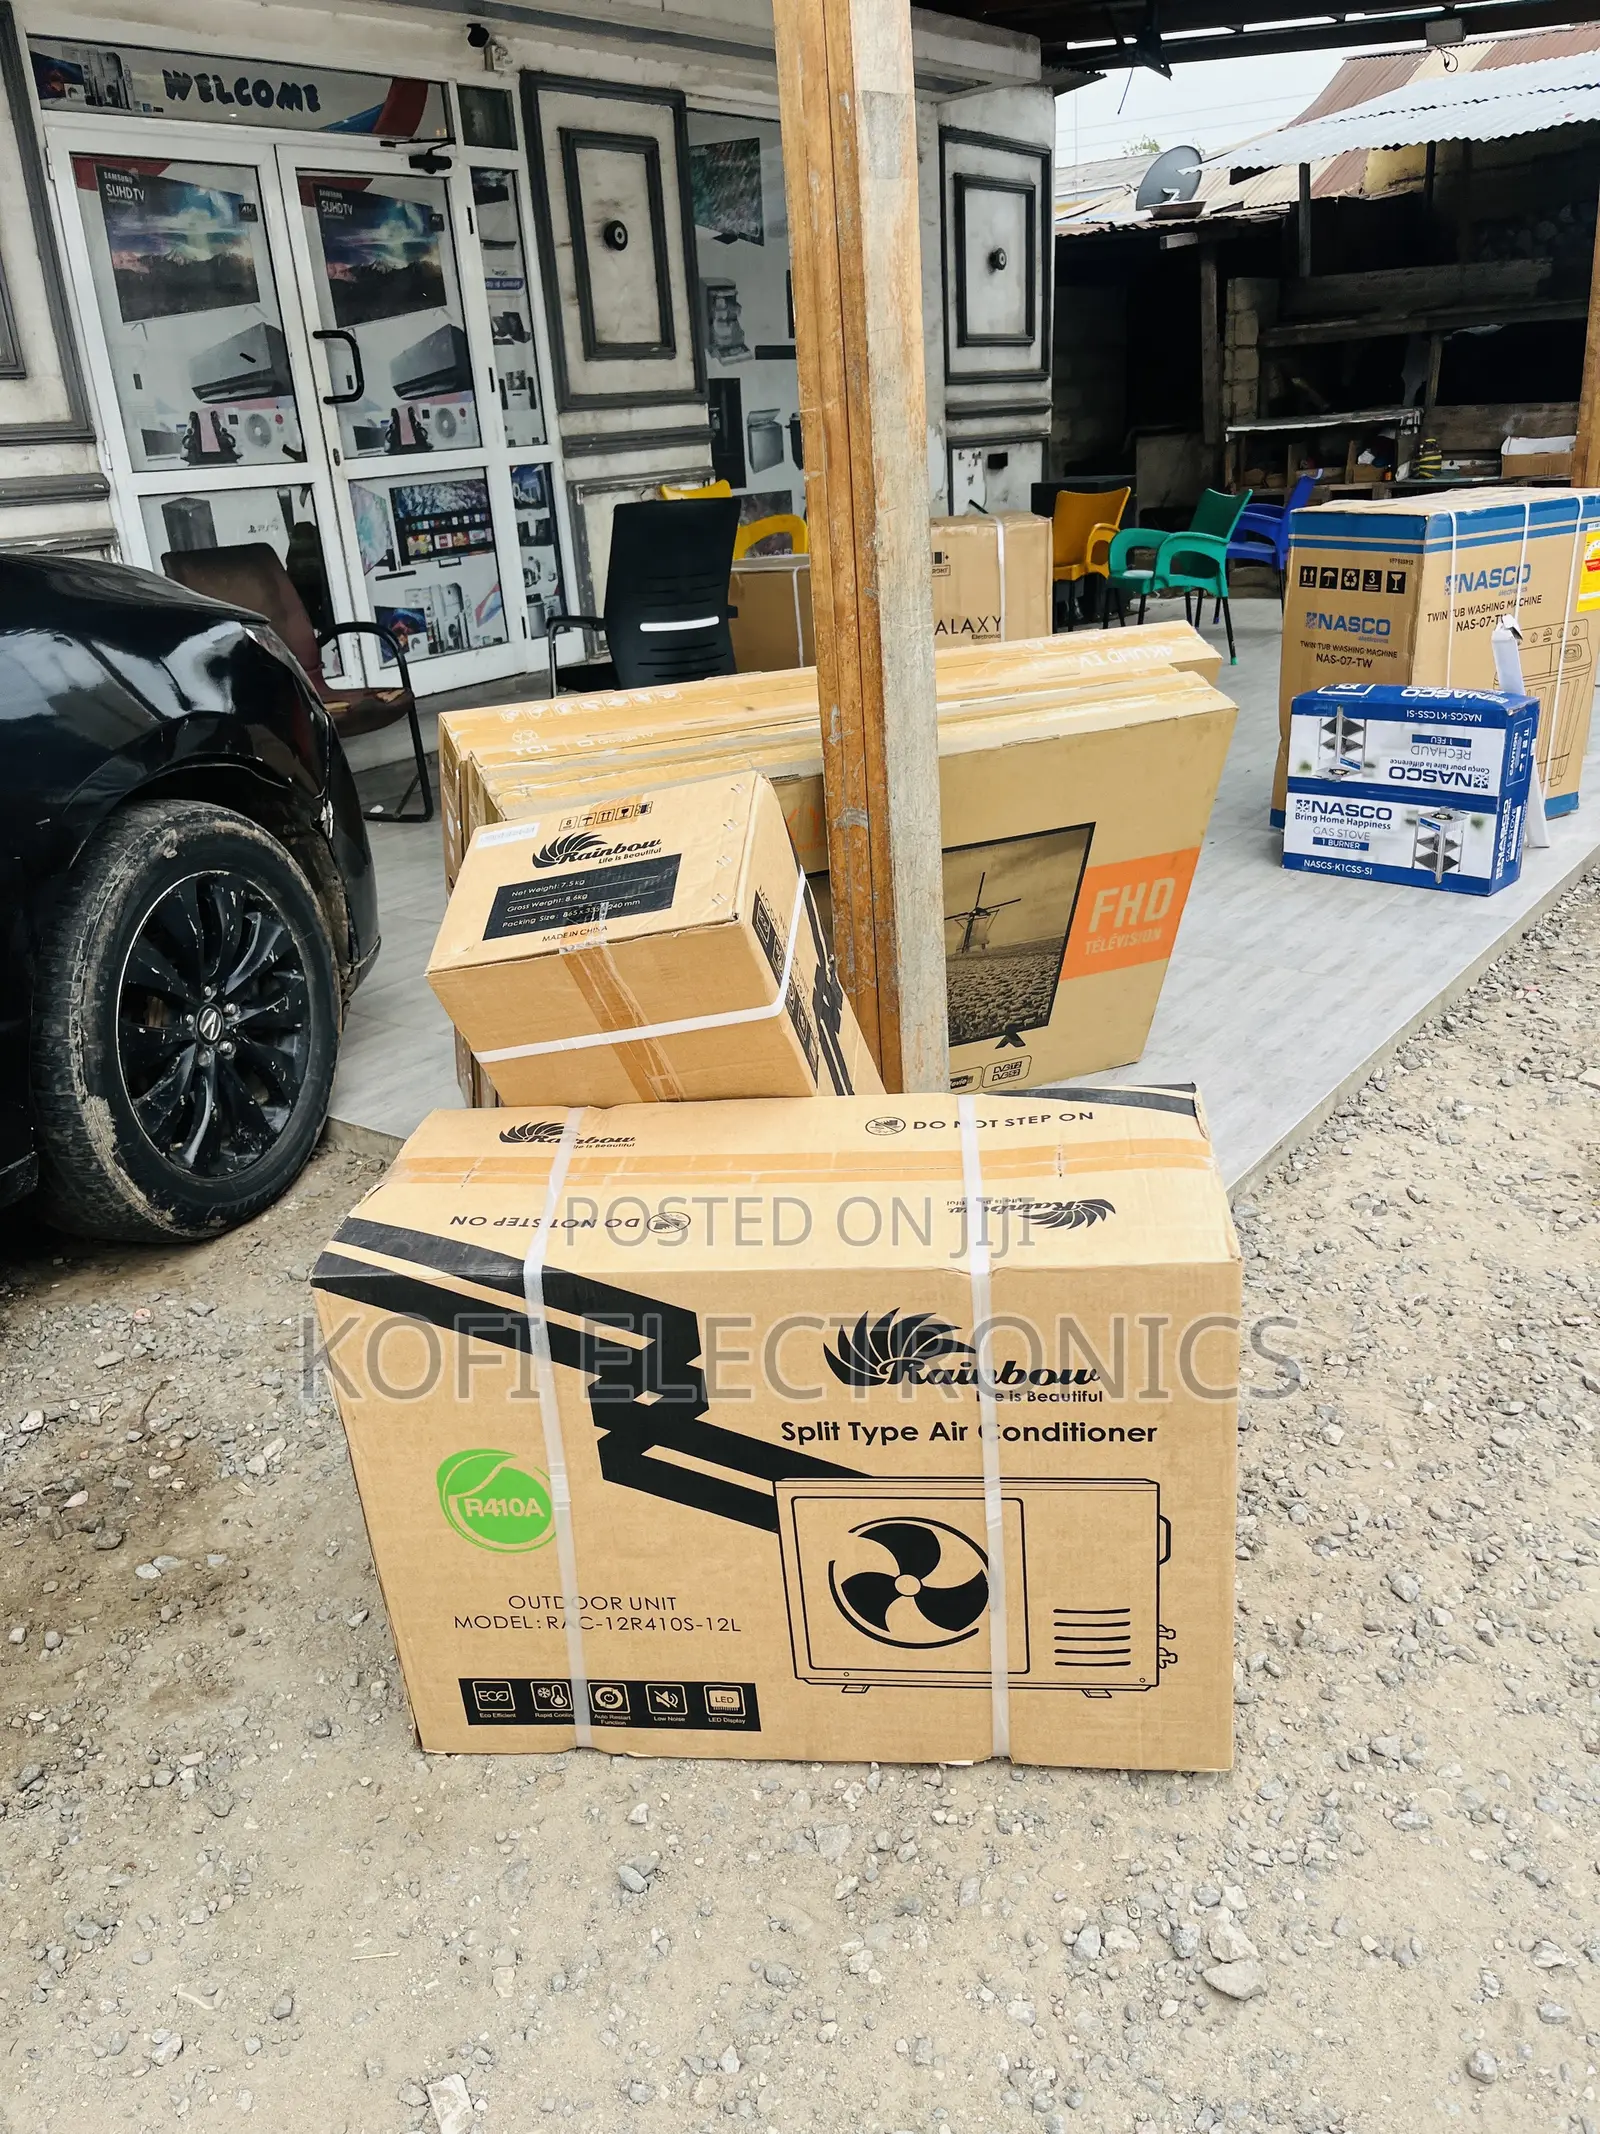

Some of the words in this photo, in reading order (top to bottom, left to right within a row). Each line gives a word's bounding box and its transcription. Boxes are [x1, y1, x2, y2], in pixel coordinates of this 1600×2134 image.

[162, 68, 320, 112] WELCOME
[1458, 564, 1532, 593] NASCO
[1427, 609, 1448, 623] TWIN
[1467, 600, 1505, 615] WASHING
[934, 615, 1002, 635] ALAXY
[1318, 612, 1391, 636] NASCO
[1300, 640, 1316, 649] TWIN
[1318, 642, 1331, 650] TUB
[1333, 644, 1365, 655] WASHING
[1366, 646, 1398, 659] MACHINE
[1316, 653, 1373, 668] NAS-07-TW
[1430, 736, 1447, 745] FEU
[510, 744, 556, 756] TCL
[1410, 745, 1472, 760] RÉCHAUD
[1433, 761, 1449, 770] faire
[1449, 763, 1467, 771] pour
[1467, 765, 1490, 774] Conçu
[1389, 766, 1473, 788] NASCO
[1312, 800, 1392, 821] NASCO
[1295, 812, 1319, 825] Bring
[1319, 814, 1345, 826] Home
[1346, 817, 1391, 830] Happiness
[1313, 826, 1331, 837] GAS
[1332, 828, 1371, 841] STOVE
[557, 838, 662, 864] Rainbow
[1328, 839, 1360, 849] BURNER
[598, 855, 613, 864] Life
[623, 848, 662, 859] Beautiful
[512, 889, 526, 897] Net
[507, 904, 530, 913] Gross
[1088, 877, 1176, 933] FHD
[502, 917, 536, 928] Packing
[542, 930, 568, 943] MADE
[1085, 927, 1162, 956] TÉLÉVISION
[913, 1120, 946, 1130] DO
[1005, 1114, 1052, 1127] STEP
[1059, 1112, 1094, 1122] ON
[450, 1216, 488, 1226] ON
[493, 1217, 541, 1228] STEP
[549, 1217, 597, 1229] NOT
[605, 1217, 640, 1228] DO
[1009, 1391, 1021, 1402] is
[1027, 1391, 1103, 1402] Beautiful
[781, 1420, 841, 1446] Split
[848, 1422, 918, 1446] Type
[929, 1420, 968, 1442] Air
[464, 1497, 546, 1518] R410A
[508, 1595, 622, 1611] OUTDOOR
[629, 1596, 677, 1611] UNIT
[715, 1696, 734, 1704] LED
[723, 1717, 746, 1725] Display
